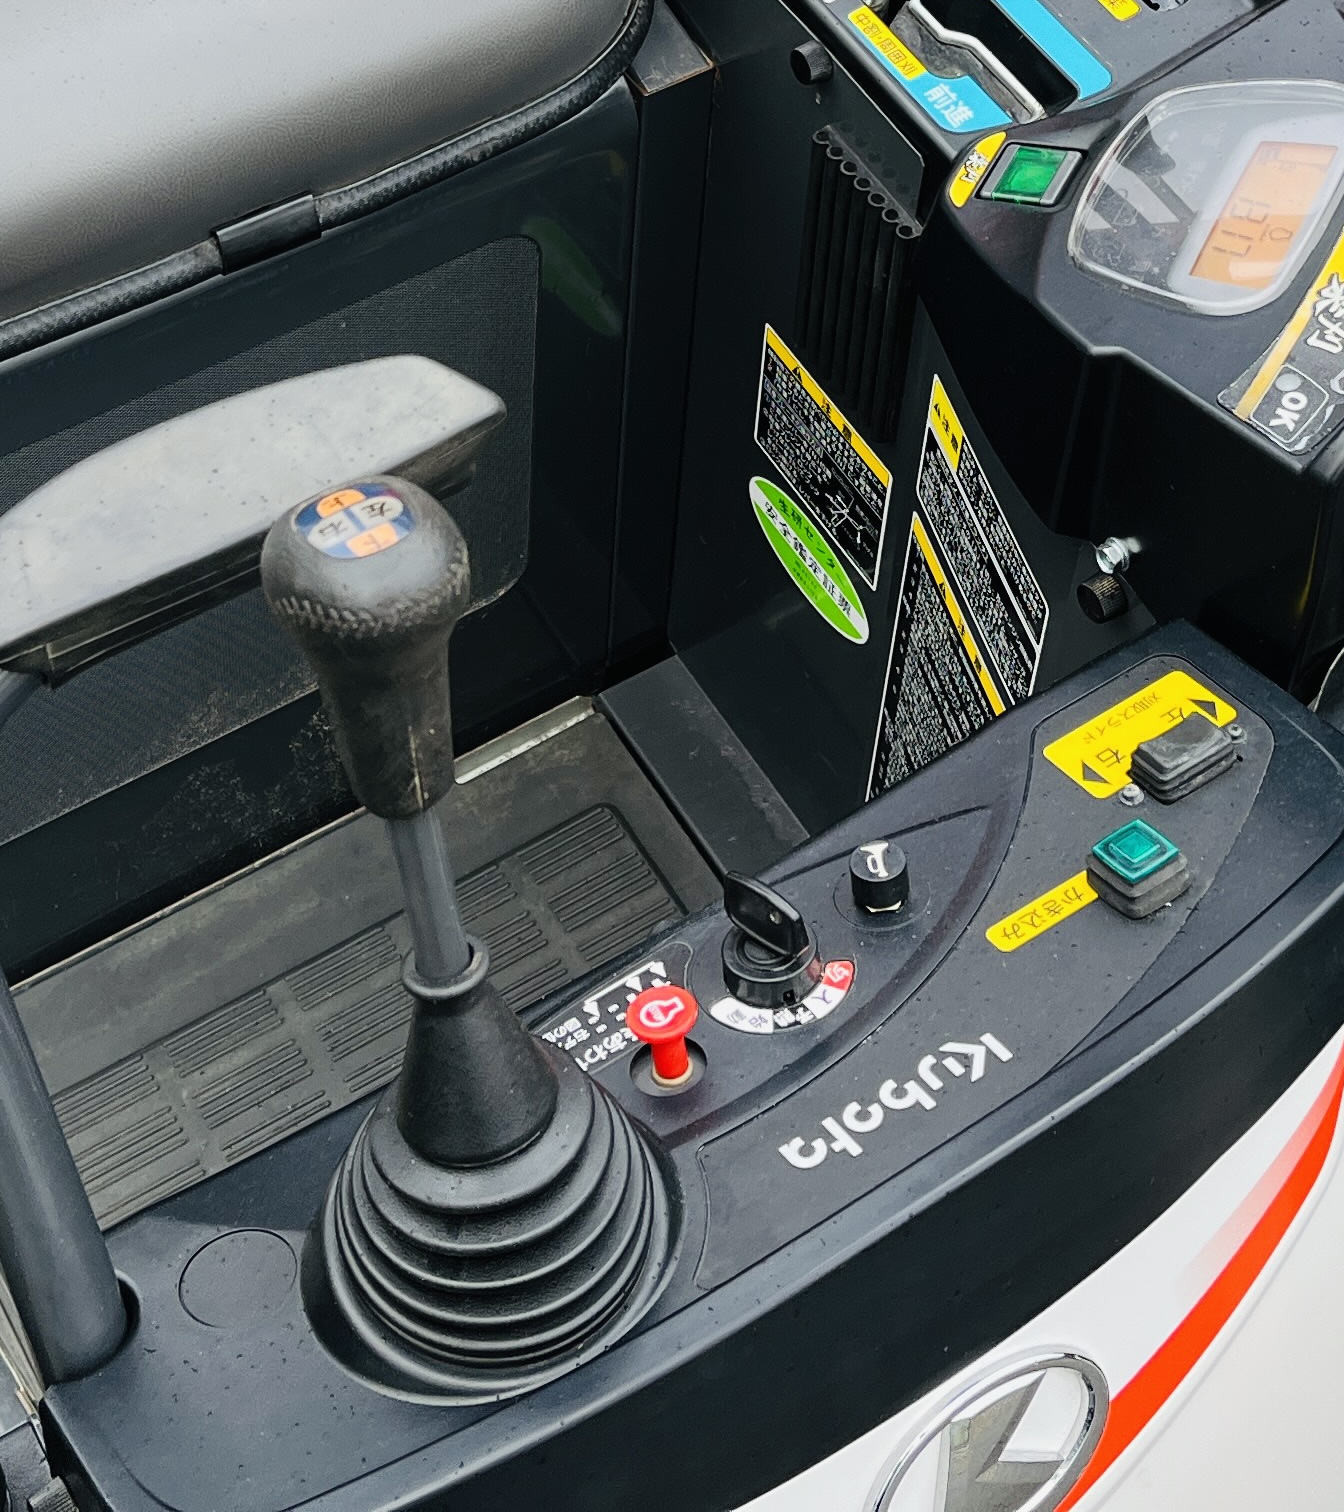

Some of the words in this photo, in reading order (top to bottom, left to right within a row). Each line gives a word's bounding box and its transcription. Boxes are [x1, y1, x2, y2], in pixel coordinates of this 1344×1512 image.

[923, 84, 975, 129] 前進
[1269, 391, 1308, 433] OK
[779, 498, 846, 588] 生研センター
[1084, 691, 1161, 745] 刈取スライド
[1096, 747, 1126, 769] 右
[1000, 886, 1085, 940] かき込み
[811, 989, 833, 1006] 入
[777, 1032, 1014, 1170] Kubota
